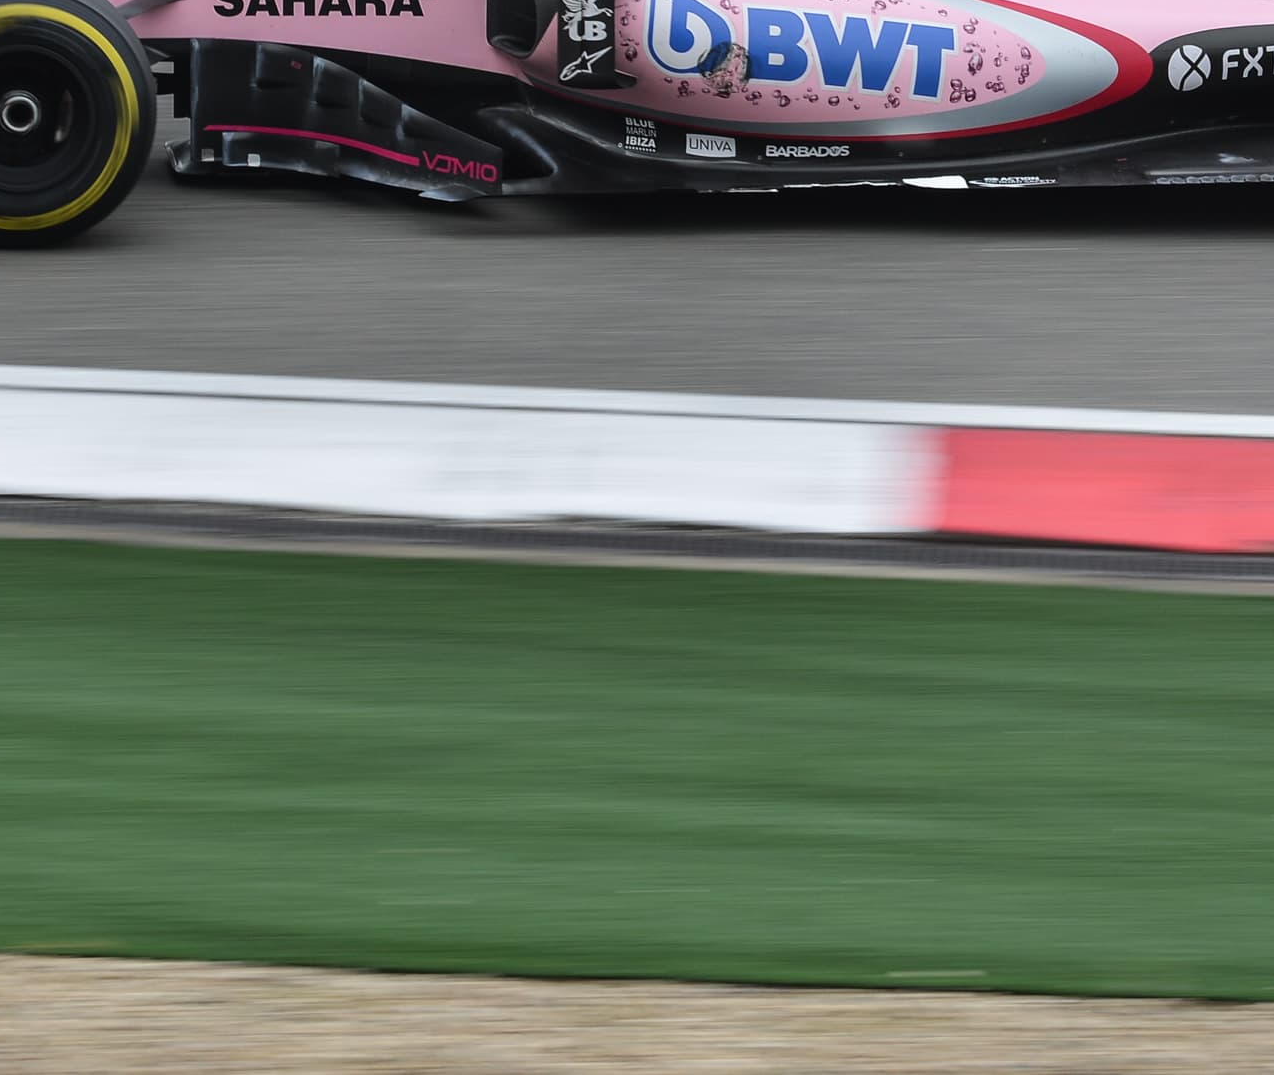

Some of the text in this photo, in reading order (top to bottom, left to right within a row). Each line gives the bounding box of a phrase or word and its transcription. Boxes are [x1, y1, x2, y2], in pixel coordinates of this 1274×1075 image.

[745, 6, 956, 100] BWT
[625, 117, 655, 129] BLUE
[625, 126, 657, 137] MARLIN
[625, 135, 656, 148] IBIZA
[689, 138, 732, 151] UNIVA
[766, 145, 850, 157] BARBADOS
